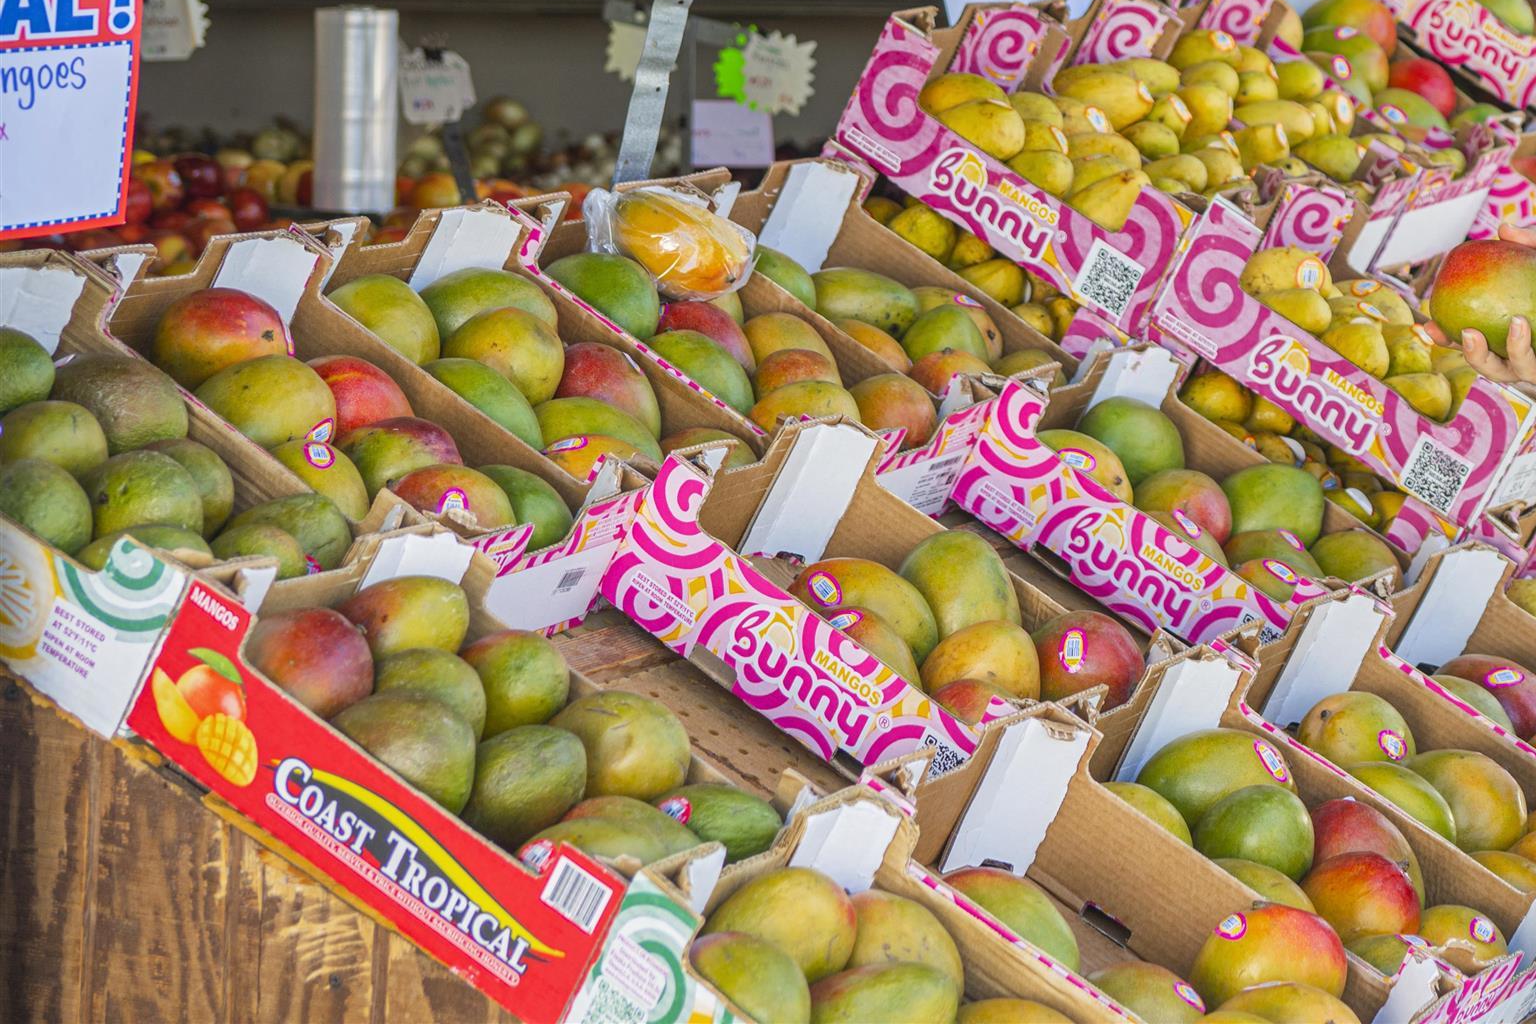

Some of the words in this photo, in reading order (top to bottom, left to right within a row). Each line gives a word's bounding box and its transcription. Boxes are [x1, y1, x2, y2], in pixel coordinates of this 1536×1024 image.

[0, 56, 87, 110] ngoes
[1000, 181, 1059, 226] MANGOS
[1327, 370, 1386, 416] MANGOS
[635, 572, 650, 584] BEST
[647, 581, 668, 597] STORED
[666, 594, 674, 602] AT
[1142, 544, 1203, 591] MANGOS
[53, 605, 75, 623] BEST
[73, 618, 107, 642] STORED
[191, 586, 240, 631] MANGOS
[630, 578, 645, 590] RIPEN
[649, 591, 663, 603] ROOM
[661, 600, 694, 625] TEMPERATURE
[51, 619, 62, 630] AT
[41, 641, 90, 679] TEMPERATURE
[43, 629, 66, 648] RIPEN
[63, 643, 74, 654] AT
[73, 650, 96, 668] ROOM
[815, 649, 882, 706] MANGOS
